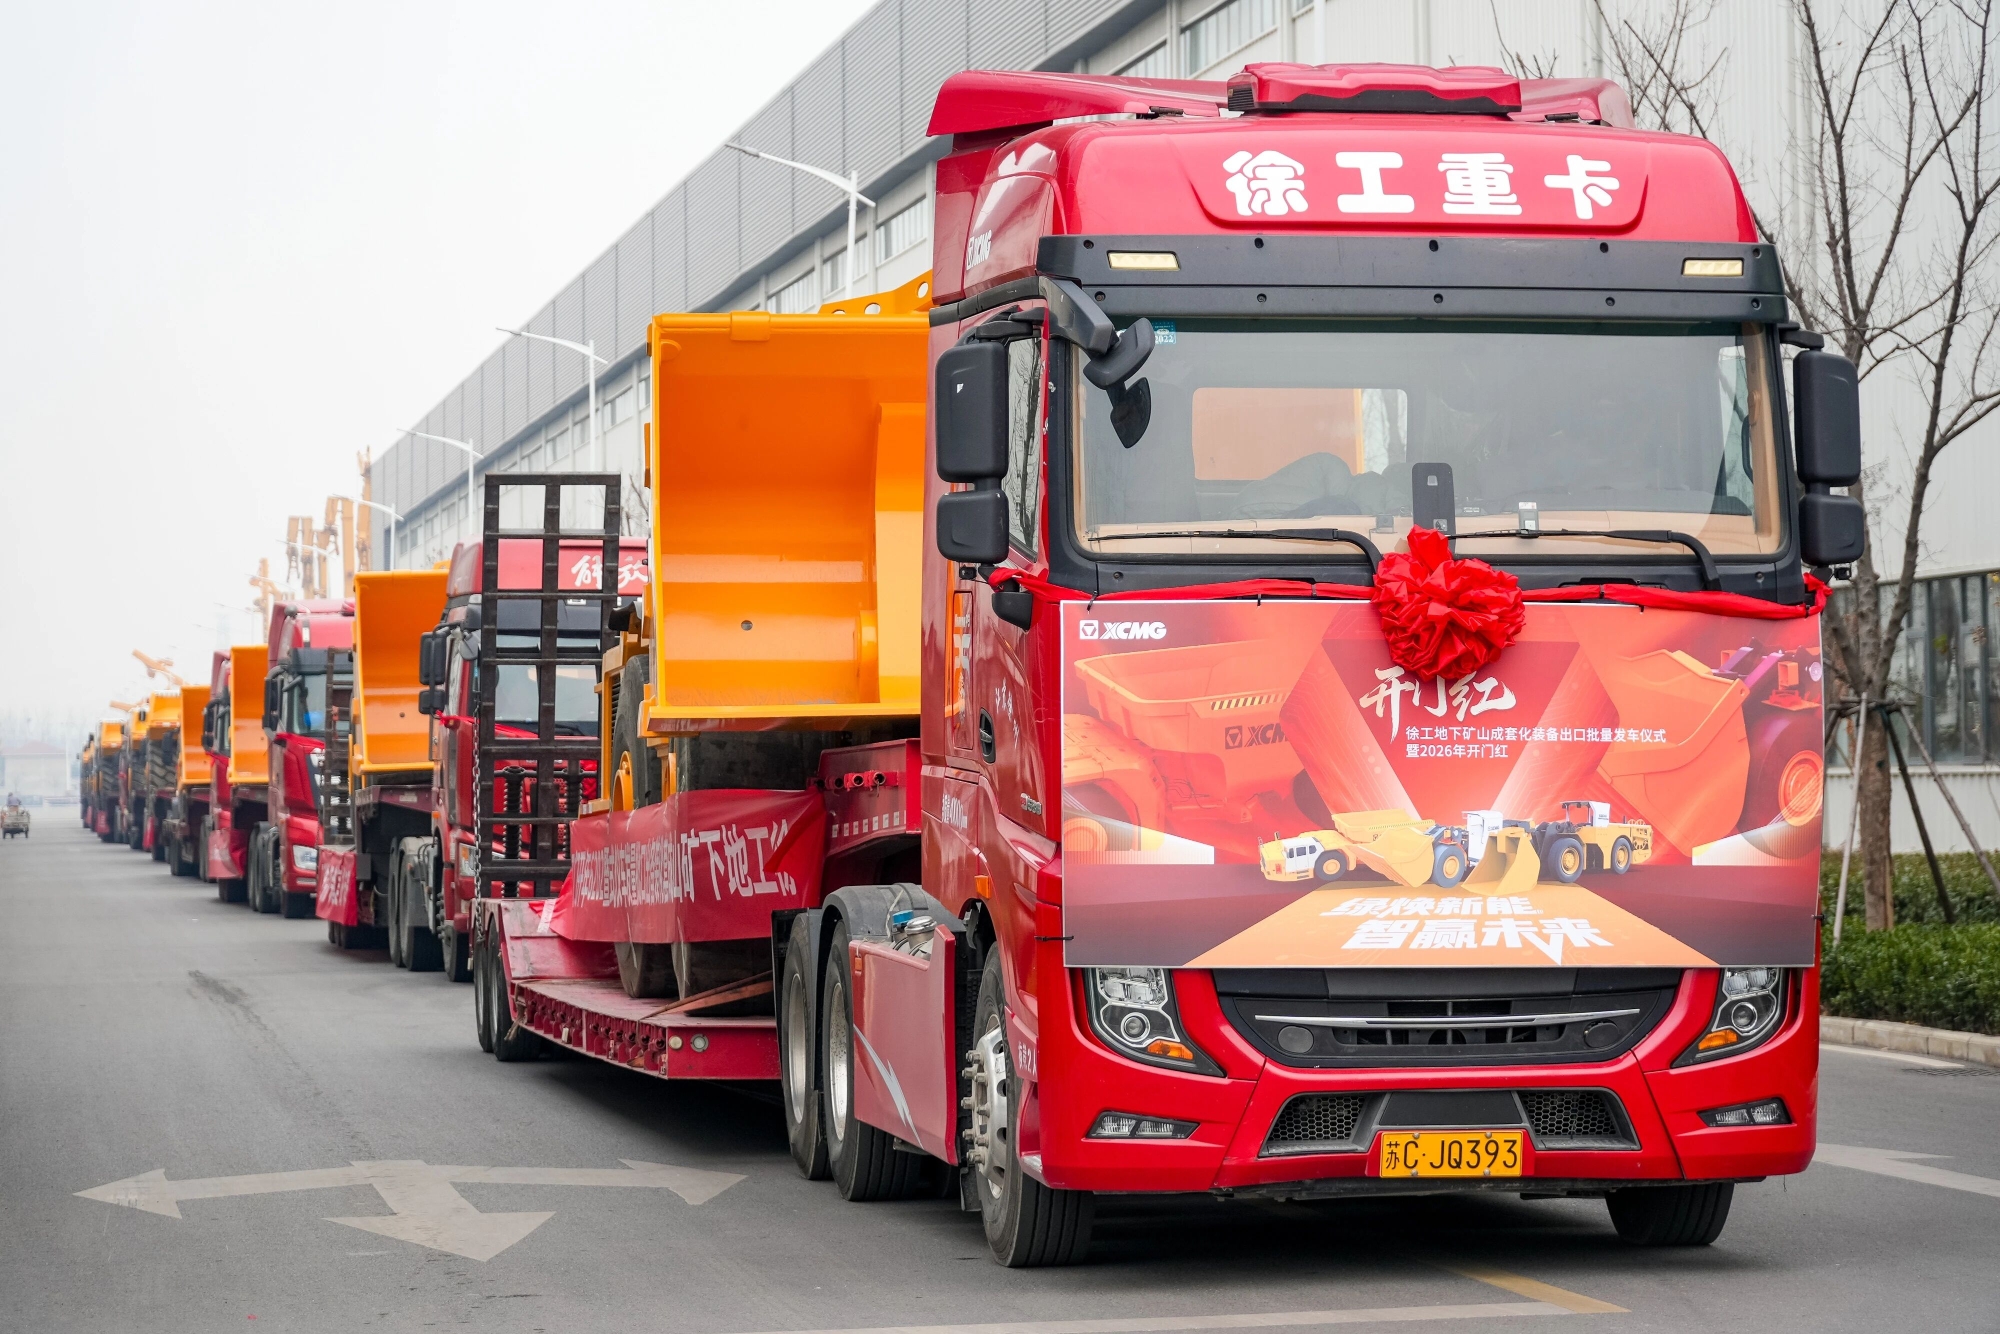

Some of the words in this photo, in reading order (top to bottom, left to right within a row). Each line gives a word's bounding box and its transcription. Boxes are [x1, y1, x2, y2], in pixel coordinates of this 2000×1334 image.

[1222, 149, 1620, 220] 徐工重卡
[1100, 621, 1167, 640] XCMG
[1358, 665, 1517, 744] 开门红
[1405, 725, 1667, 743] 徐工地下矿山成套化装备出口批量发车仪式
[1405, 743, 1509, 759] 暨2026年开门红
[1340, 917, 1615, 966] 智赢未来
[1385, 1139, 1518, 1170] 苏C·JQ393
